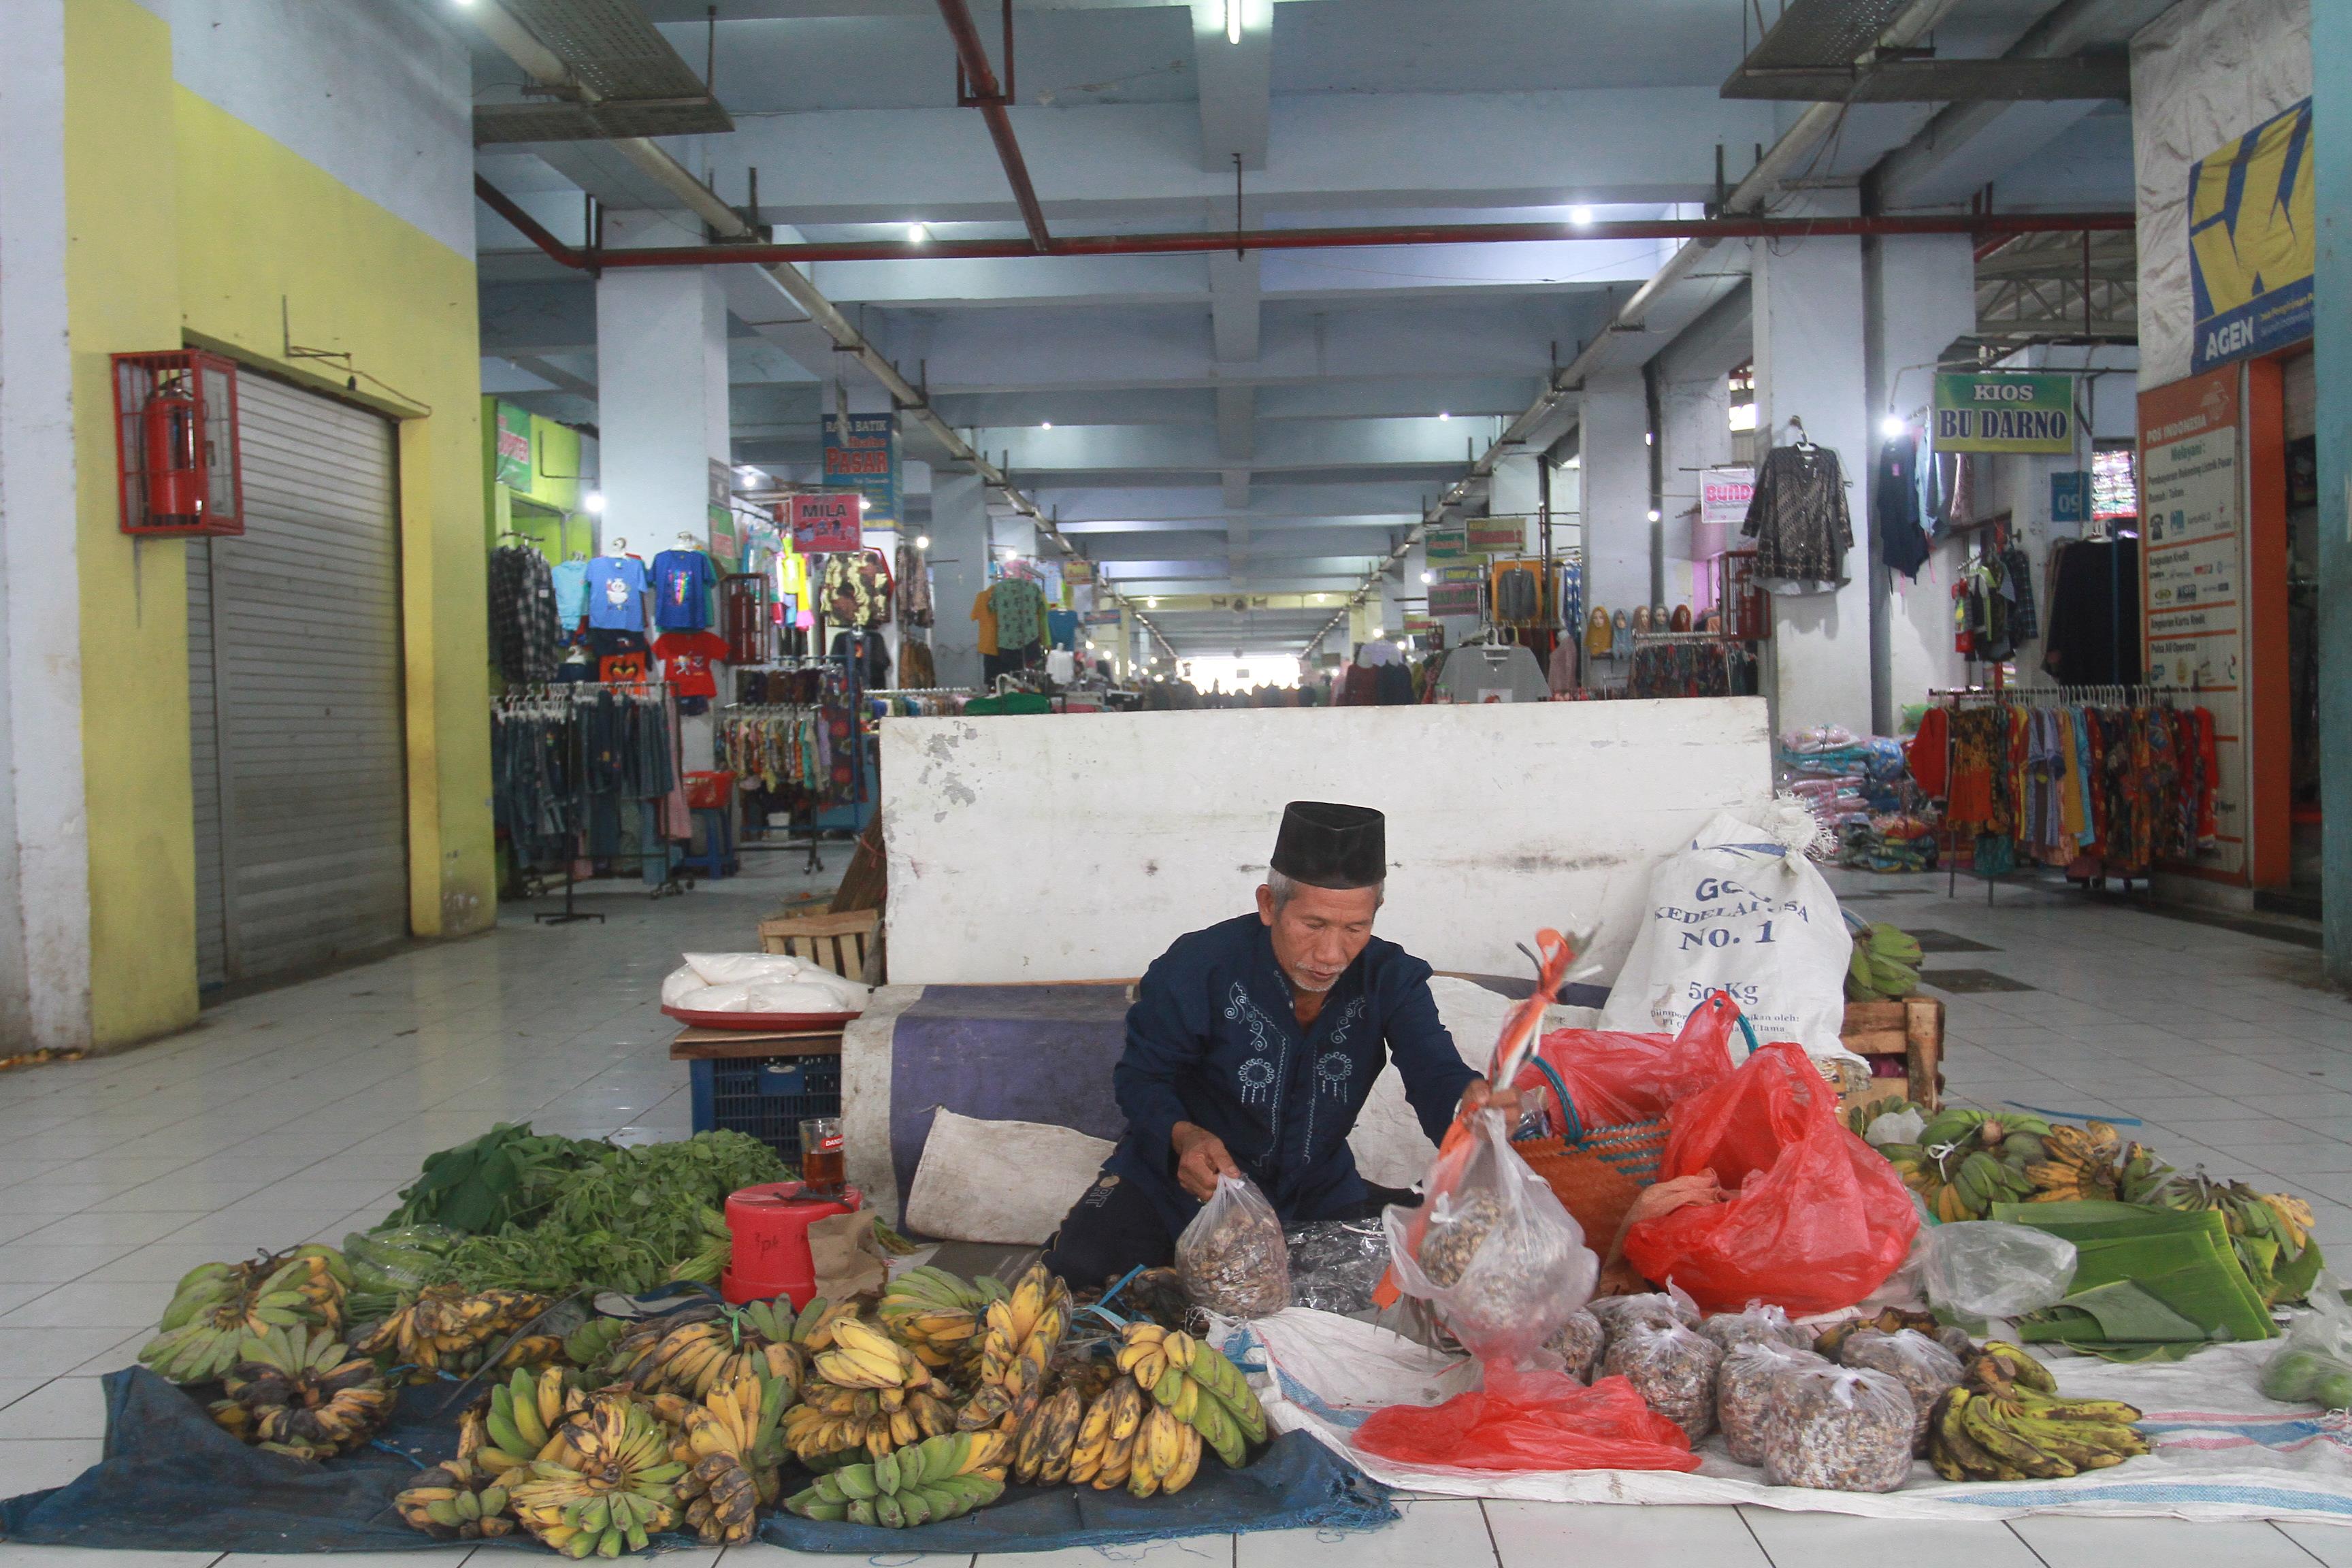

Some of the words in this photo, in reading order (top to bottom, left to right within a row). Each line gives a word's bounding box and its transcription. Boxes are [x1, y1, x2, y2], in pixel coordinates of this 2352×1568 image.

[2206, 316, 2253, 361] AGEN
[1974, 385, 2034, 401] KIOS
[855, 420, 887, 432] BATIK
[1939, 409, 1972, 439] BU
[1980, 409, 2068, 440] DARNO
[2163, 414, 2206, 439] INDONESIA
[825, 446, 889, 474] PASAR
[1704, 483, 1754, 502] BUND
[802, 504, 847, 518] MILA
[1678, 926, 1740, 951] NO.
[1754, 919, 1776, 944] 1
[1725, 981, 1759, 1006] Kg
